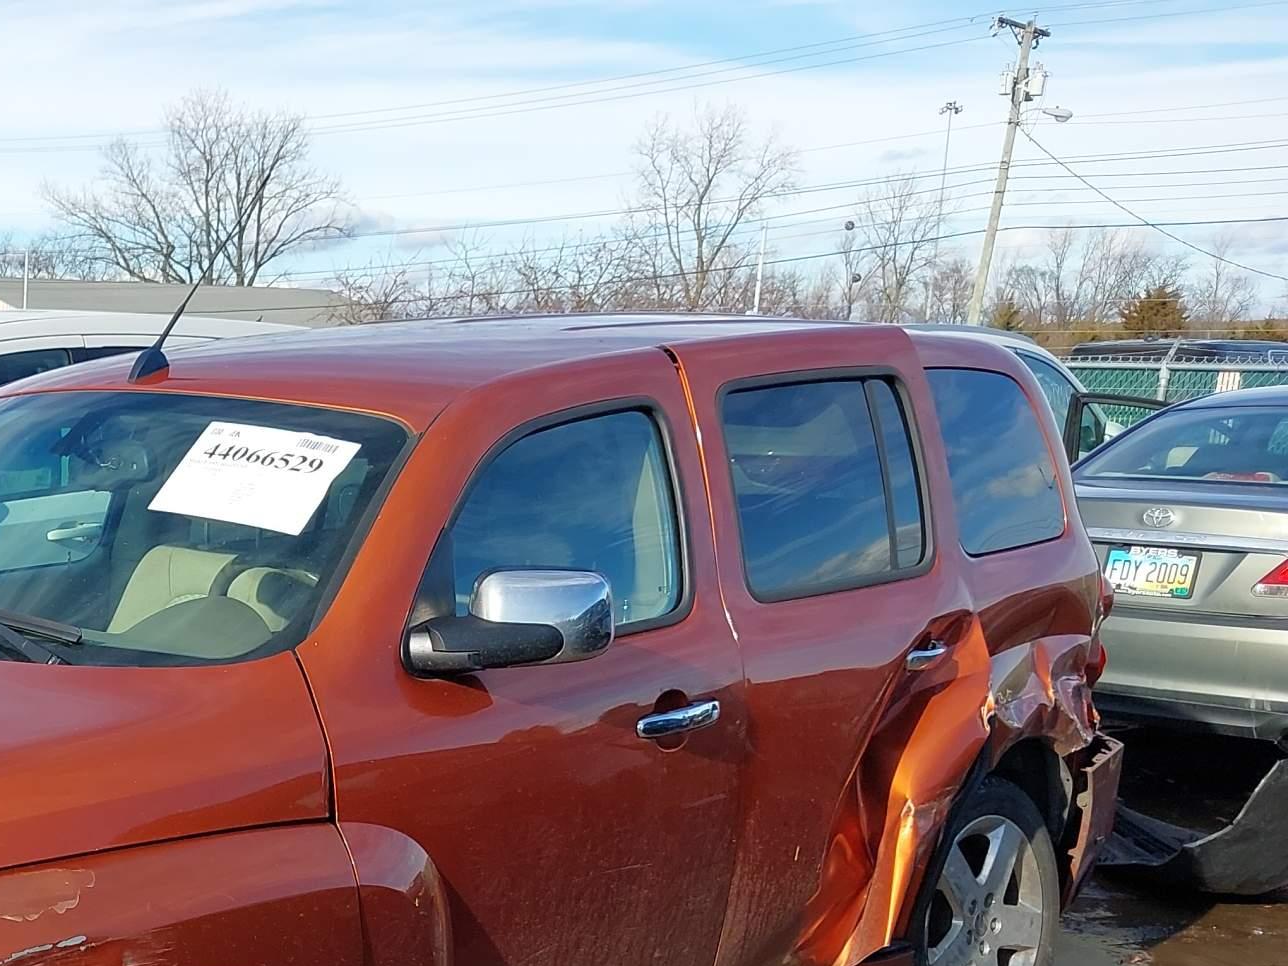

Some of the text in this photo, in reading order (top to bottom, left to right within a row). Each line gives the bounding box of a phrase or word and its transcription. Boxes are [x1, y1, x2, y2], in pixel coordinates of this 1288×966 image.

[203, 443, 324, 474] 44066529
[1131, 546, 1178, 559] BYERS
[1110, 559, 1189, 585] FDY 2009
